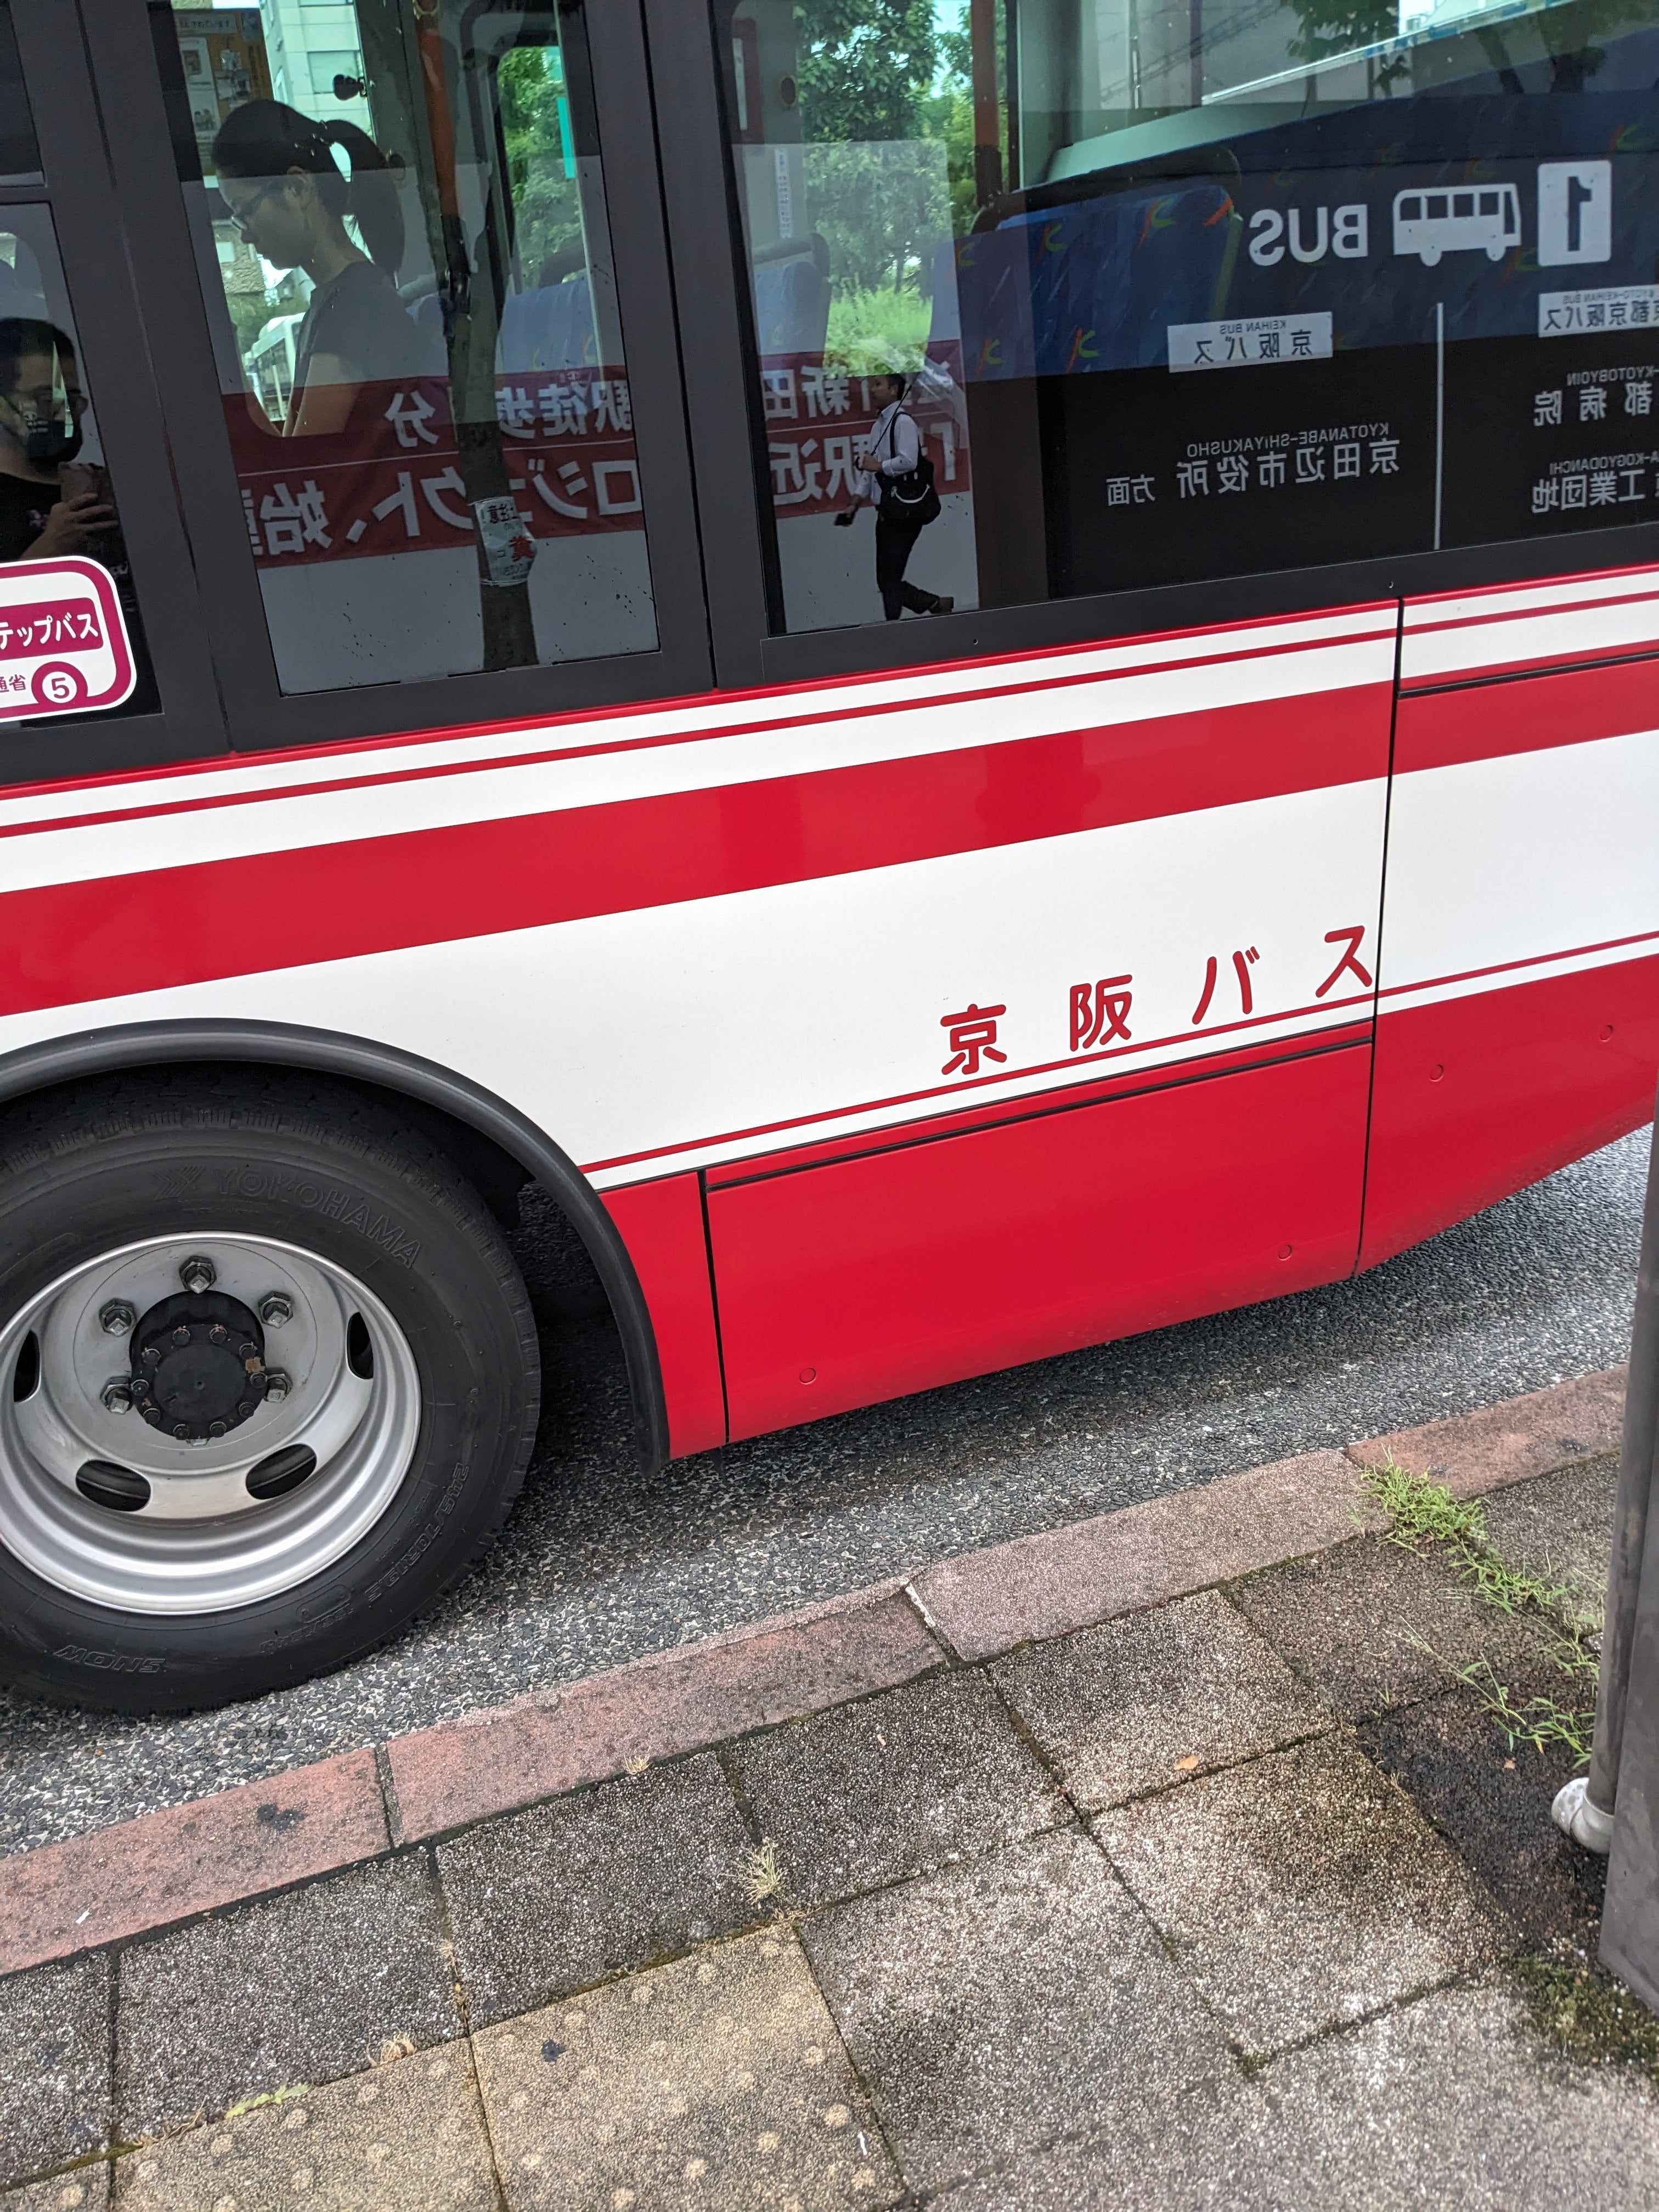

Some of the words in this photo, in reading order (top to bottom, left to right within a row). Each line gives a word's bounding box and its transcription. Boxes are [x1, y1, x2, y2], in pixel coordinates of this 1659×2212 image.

[940, 925, 1373, 1075] 京阪バス
[217, 1166, 422, 1269] YOKOHAMA
[53, 1643, 167, 1675] SNOW
